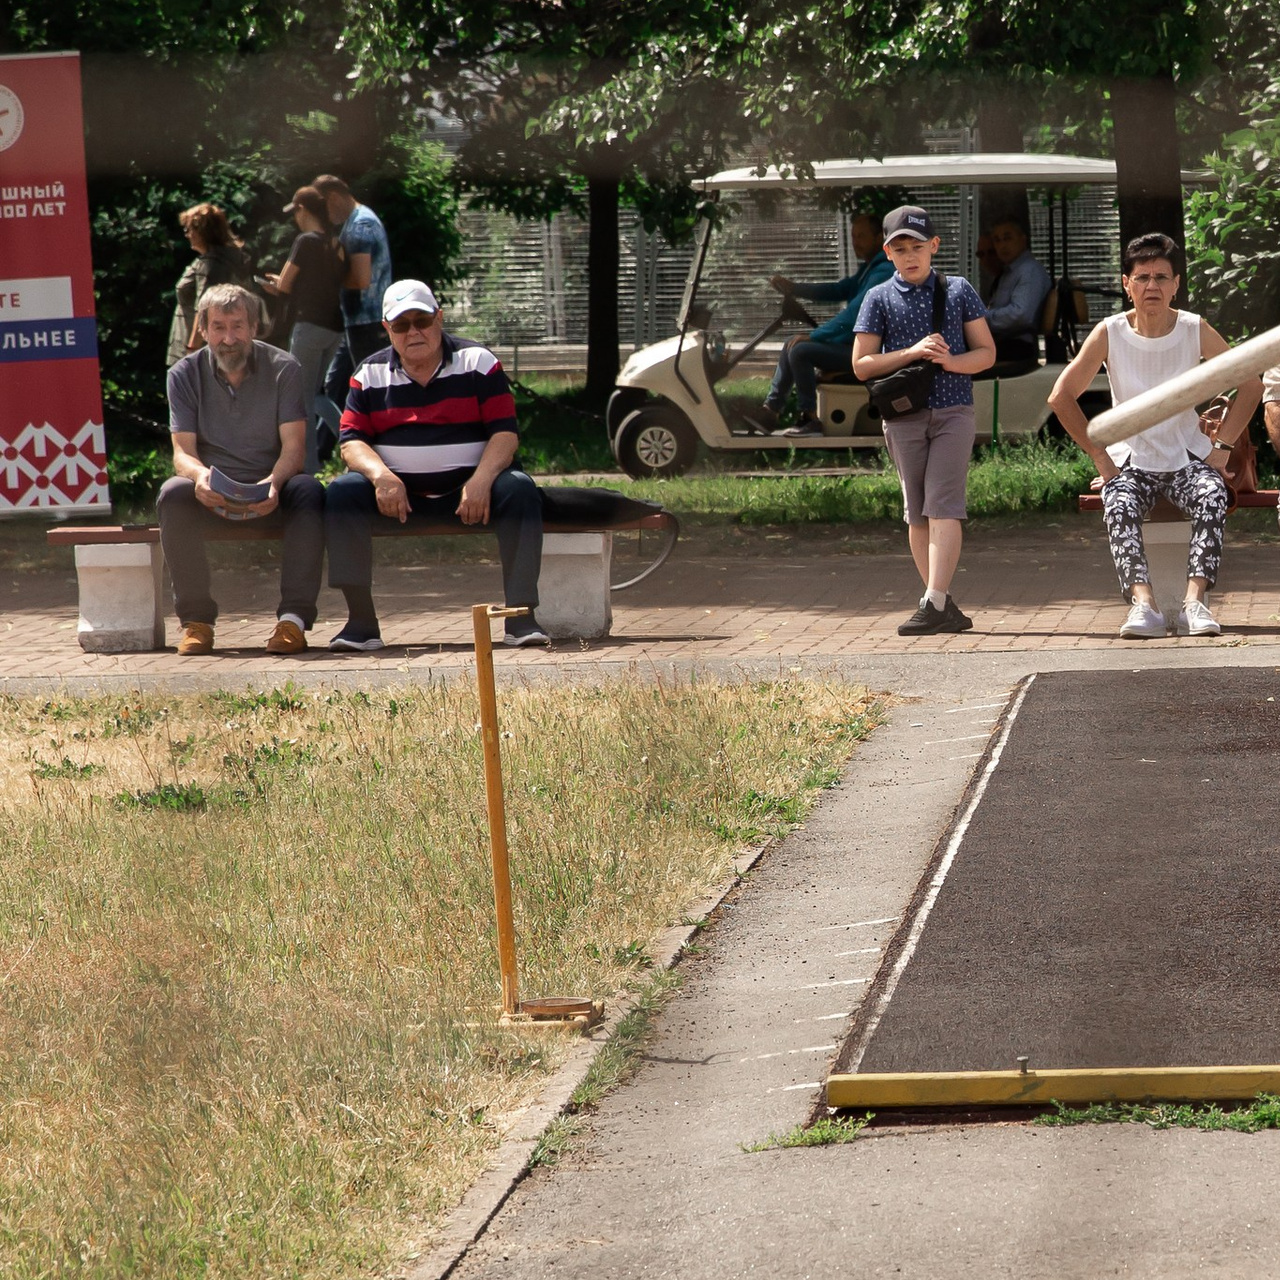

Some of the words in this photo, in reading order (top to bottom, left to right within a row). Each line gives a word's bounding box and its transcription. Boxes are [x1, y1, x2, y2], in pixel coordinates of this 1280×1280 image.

[0, 204, 27, 219] 00
[32, 202, 66, 217] ЛЕТ
[3, 330, 76, 350] ЛЬНЕЕ
